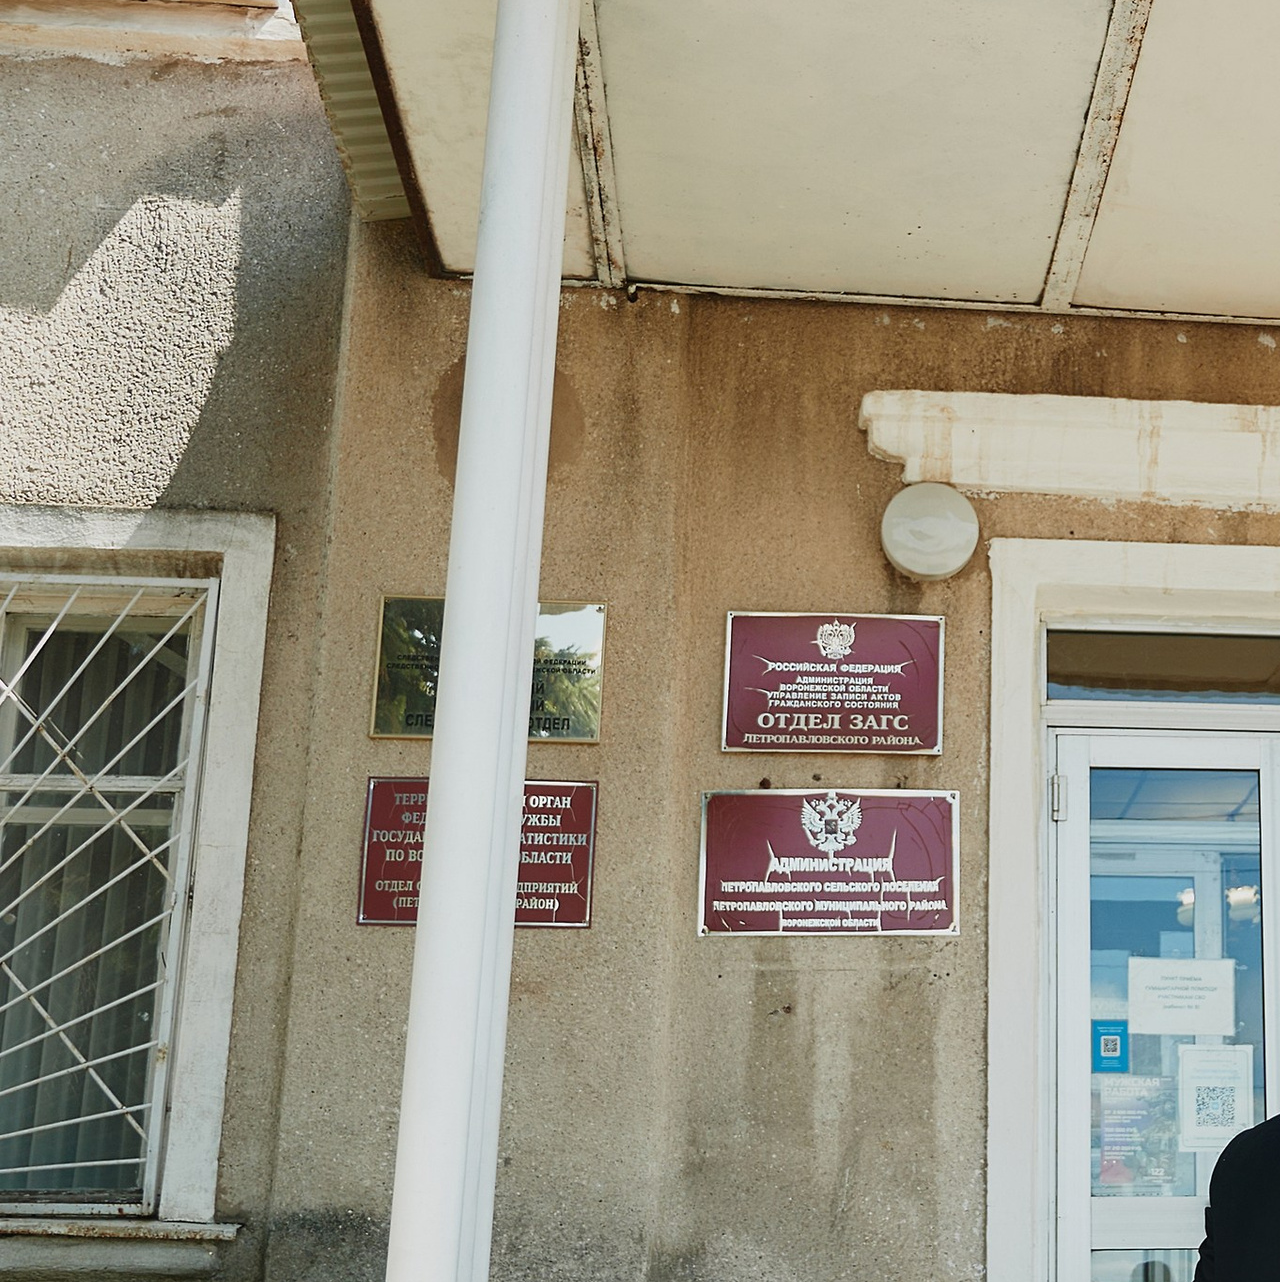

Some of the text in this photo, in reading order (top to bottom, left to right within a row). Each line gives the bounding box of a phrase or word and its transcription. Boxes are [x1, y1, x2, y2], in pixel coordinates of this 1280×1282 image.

[769, 662, 902, 674] РОССИЙСКАЯ ФЕДЕРАЦИЯ
[796, 676, 874, 685] АДМИНИСТРАЦИЯ
[780, 683, 889, 693] ВОРОНЕЖСКОЙ ОБЛАСТИ
[767, 692, 901, 701] УПРАВЛЕНИЕ ЗАПИСИ АКТОВ
[768, 700, 899, 709] ГРАЖДАНСКОГО СОСТОЯНИЯ
[757, 713, 909, 731] ОТДЕЛ ЗАГС
[743, 733, 923, 745] ПЕТРОПАВЛОВСКОГО РАЙОНА
[530, 796, 571, 808] ОРГАН
[521, 814, 561, 826] УЖБЫ
[386, 850, 405, 861] ПО
[521, 852, 572, 864] БЛАСТИ
[770, 857, 893, 873] АДМИНИСТРАЦИЯ
[375, 881, 413, 892] ОТДЕЛ
[721, 881, 821, 893] ПЕТРОПАВЛОВСКОГО
[823, 881, 880, 893] СЕЛЬСКОГО
[713, 899, 948, 912] ПЕТРОПАВЛОВСКОГО МУНИЦИПАЛЬНОГО РАЙОНА
[782, 918, 880, 928] ВОРОНЕЖСКОЙ ОБЛАСТИ
